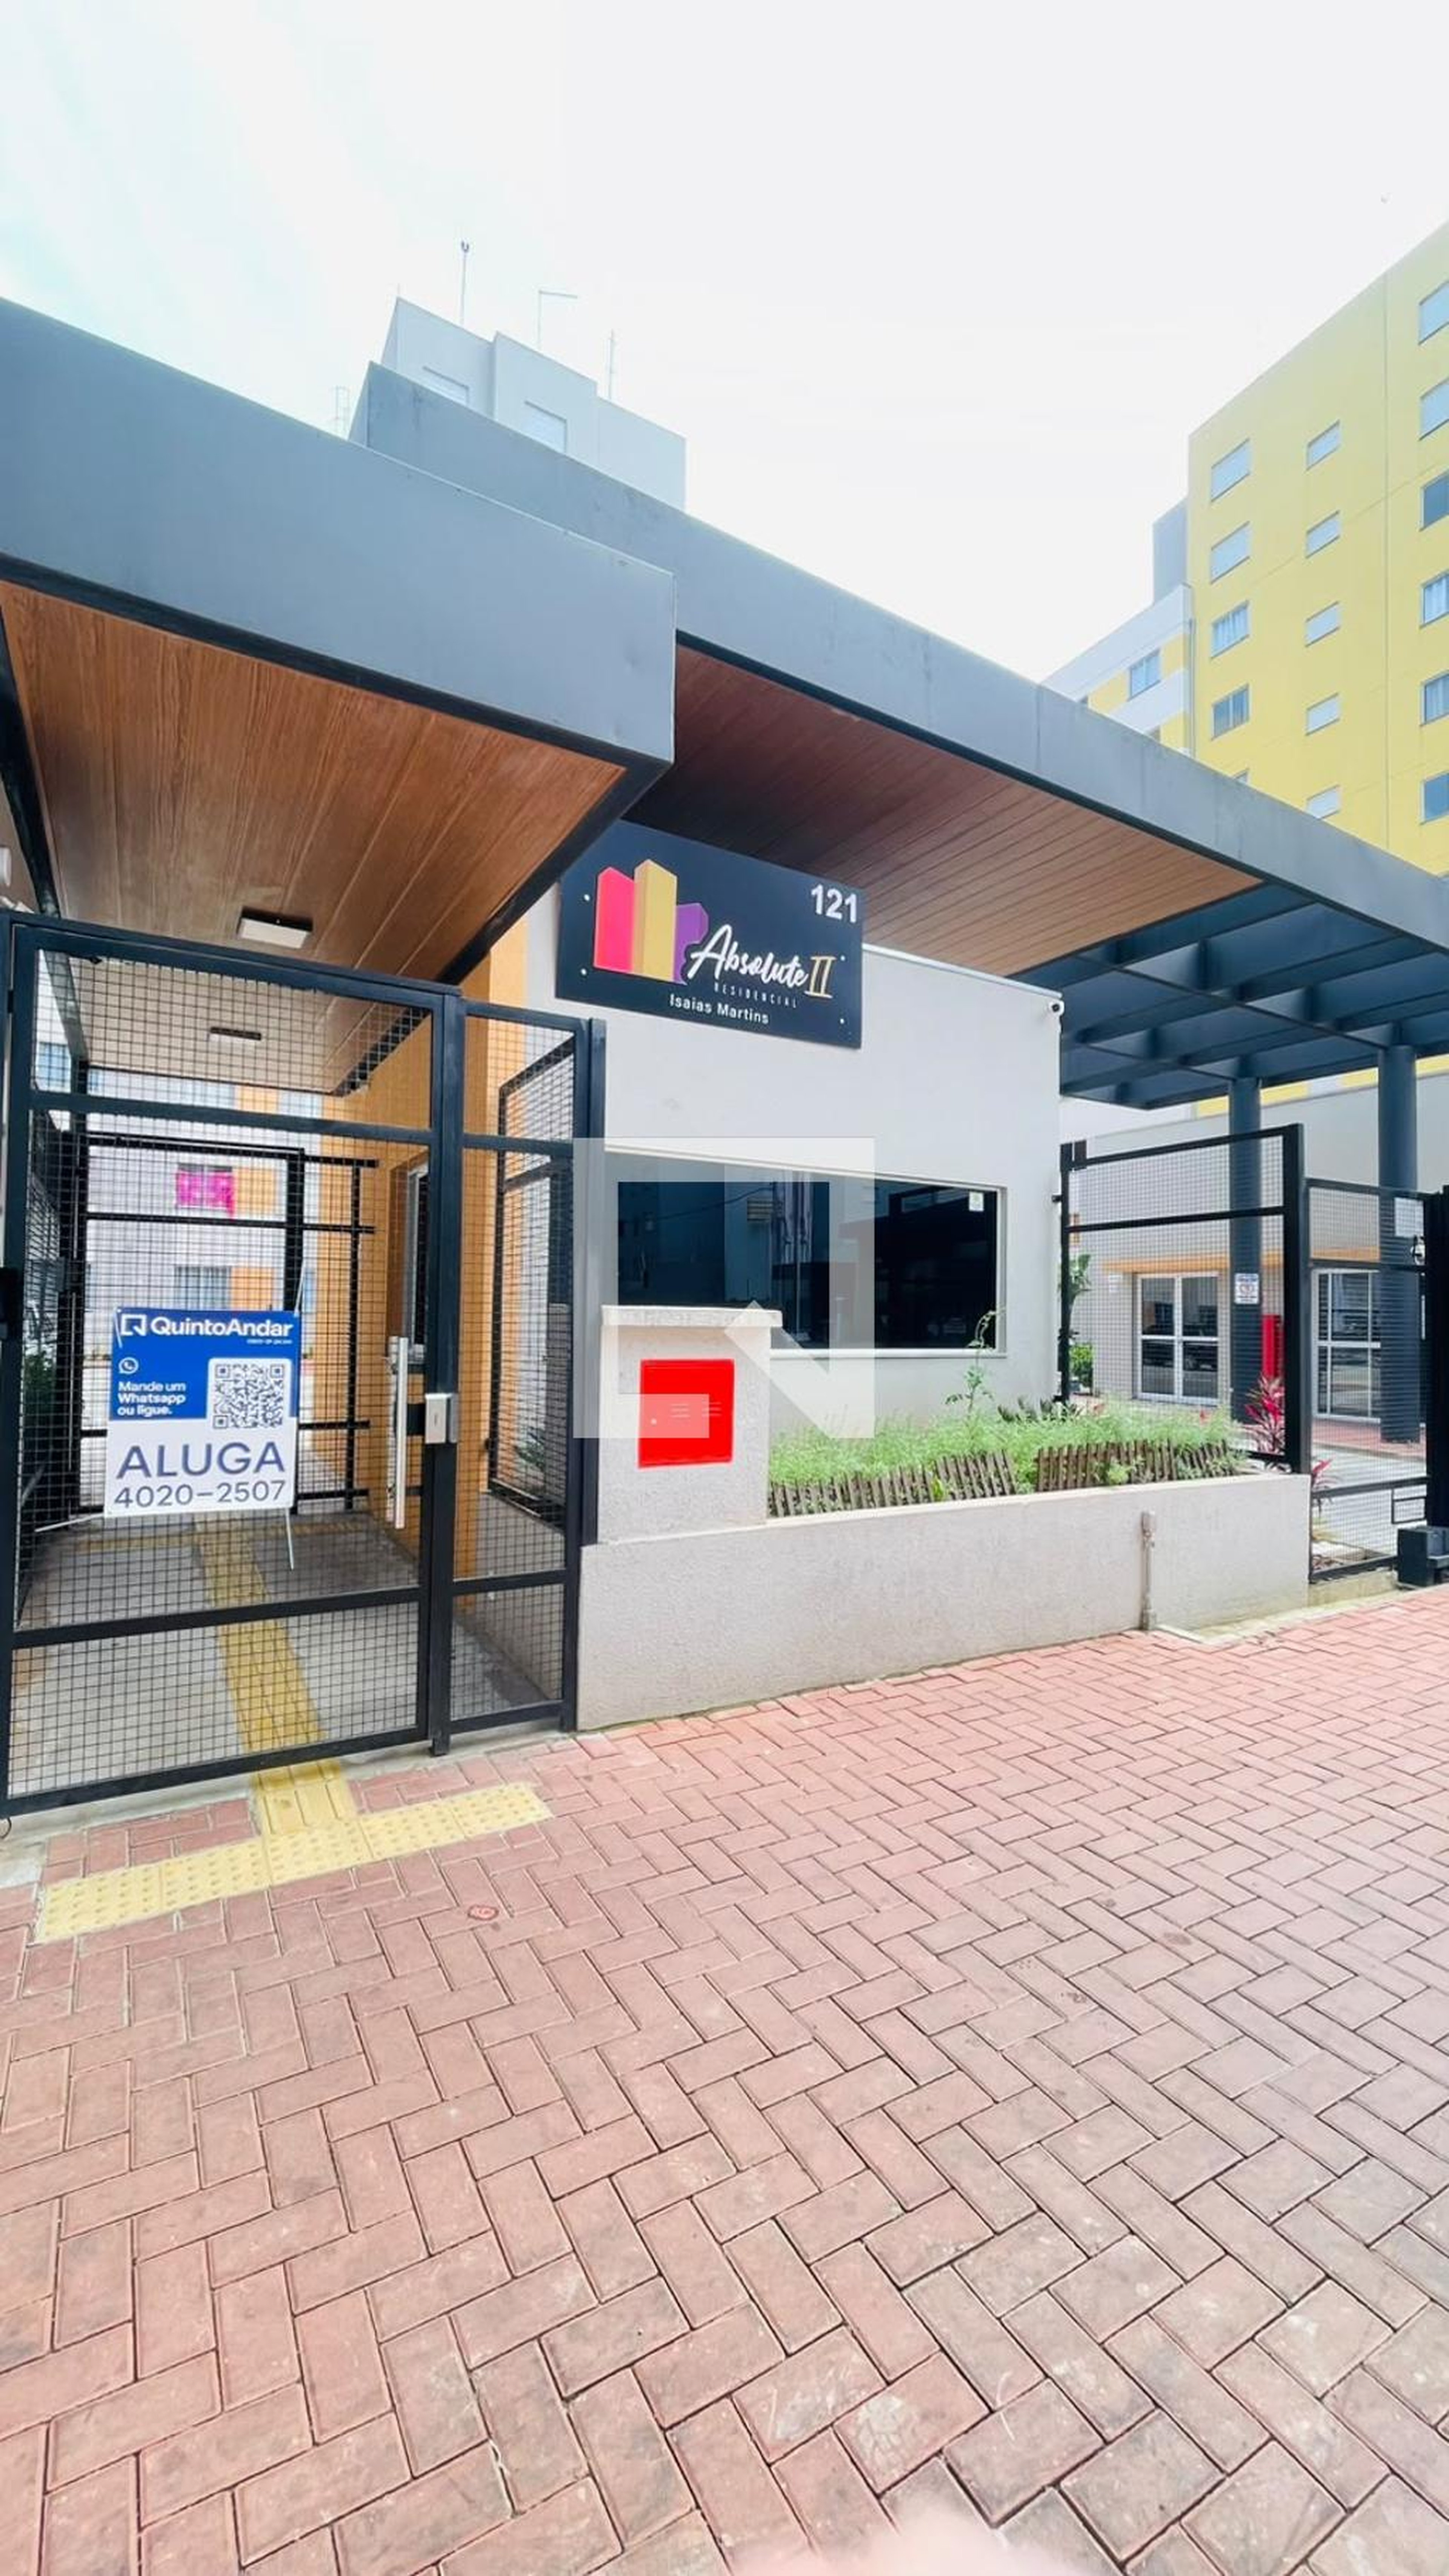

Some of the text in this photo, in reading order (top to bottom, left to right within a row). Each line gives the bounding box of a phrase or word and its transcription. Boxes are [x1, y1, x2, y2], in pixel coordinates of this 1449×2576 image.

[811, 884, 857, 924] 121
[687, 924, 809, 988] Absolute
[717, 1002, 769, 1025] Martins
[151, 1316, 294, 1337] QuintoAndar
[118, 1381, 186, 1392] Mande um
[118, 1393, 186, 1404] Whatsapp
[117, 1404, 172, 1417] ou ligue.
[116, 1442, 285, 1480] ALUGA
[114, 1480, 286, 1509] 4020-2507
